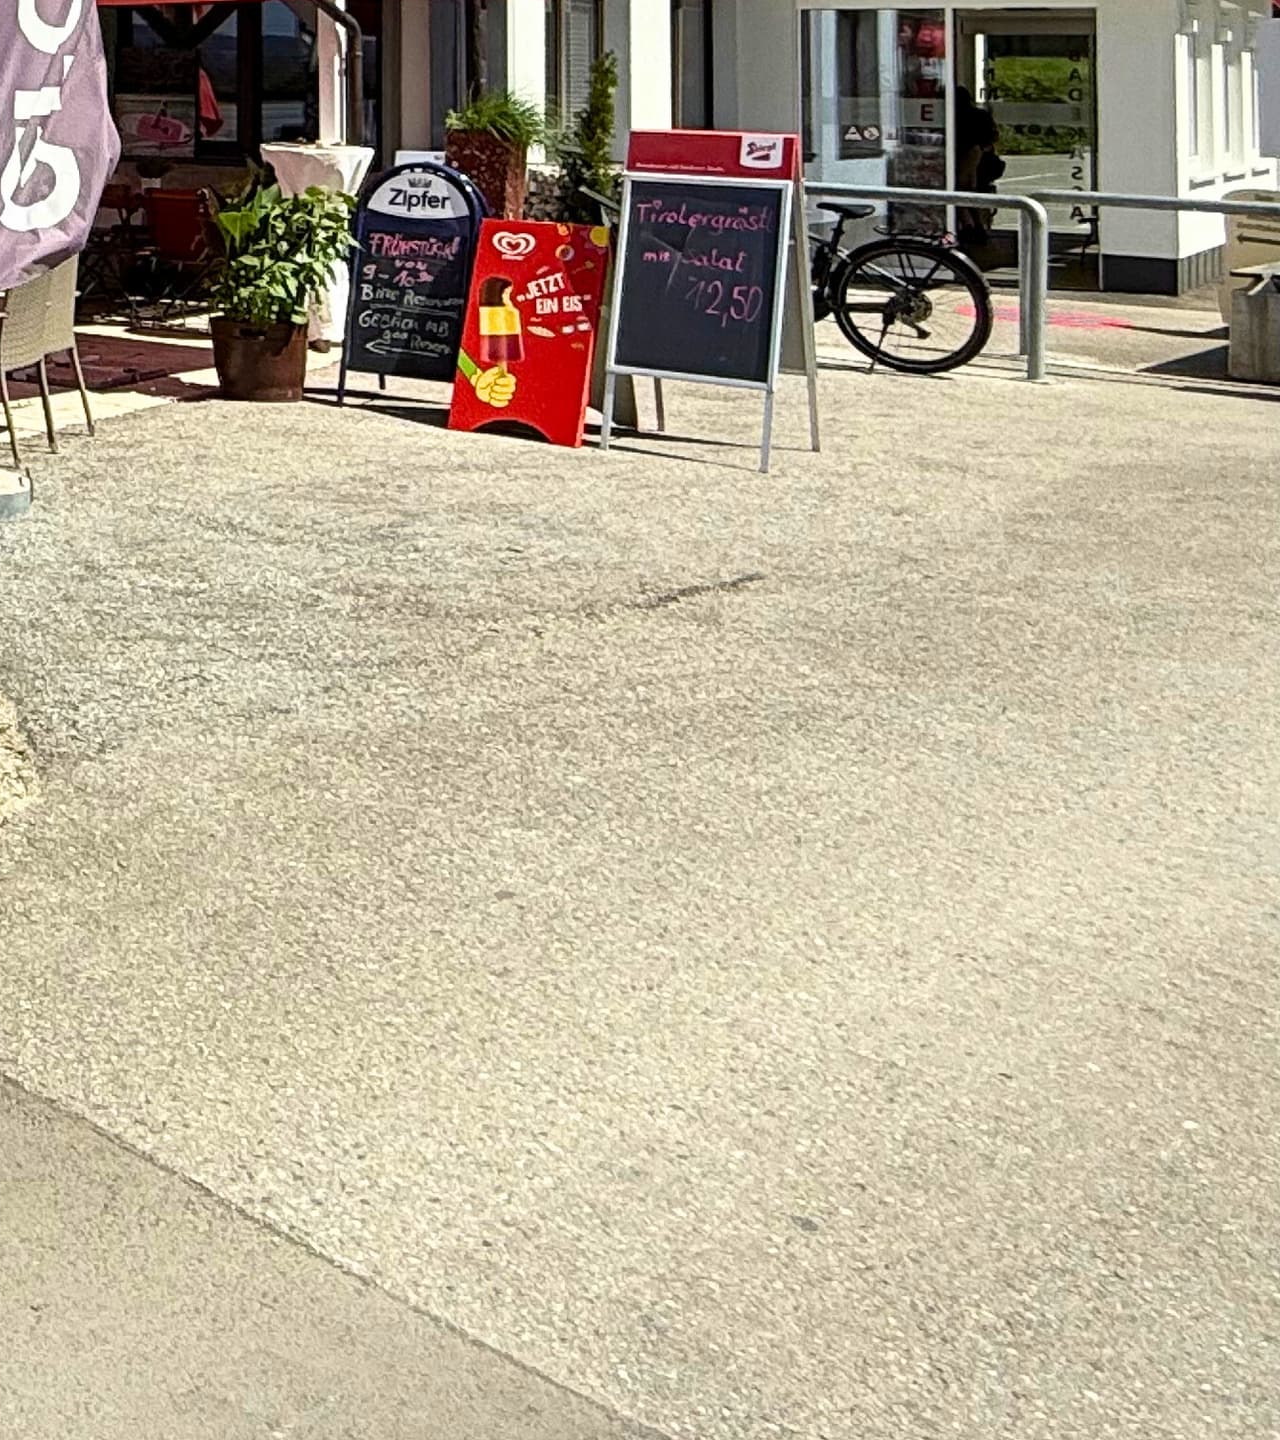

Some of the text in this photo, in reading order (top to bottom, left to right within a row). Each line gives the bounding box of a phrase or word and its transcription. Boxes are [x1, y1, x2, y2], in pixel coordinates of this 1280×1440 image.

[388, 187, 452, 212] Zipfer
[642, 250, 672, 262] mit
[535, 297, 559, 314] EIN
[684, 276, 764, 329] 12,50
